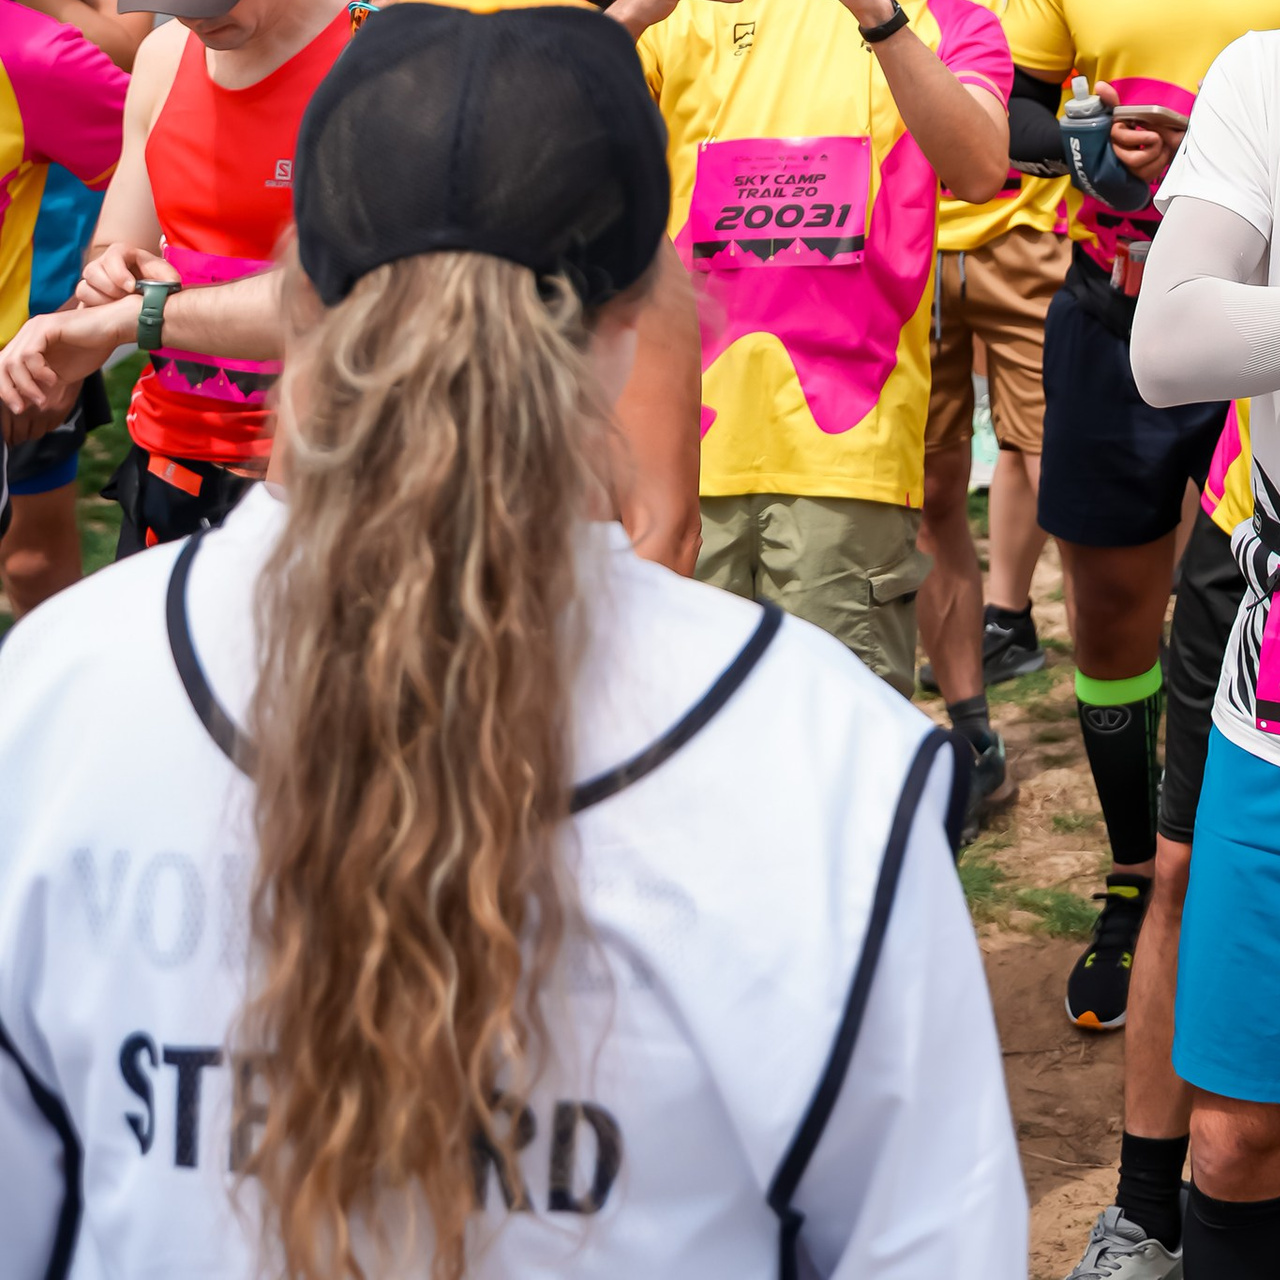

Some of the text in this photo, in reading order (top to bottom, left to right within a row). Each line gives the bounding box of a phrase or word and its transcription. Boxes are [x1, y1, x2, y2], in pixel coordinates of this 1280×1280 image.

[734, 173, 827, 187] SKY CAMP
[737, 186, 819, 199] TRAIL 20
[714, 203, 852, 231] 20031
